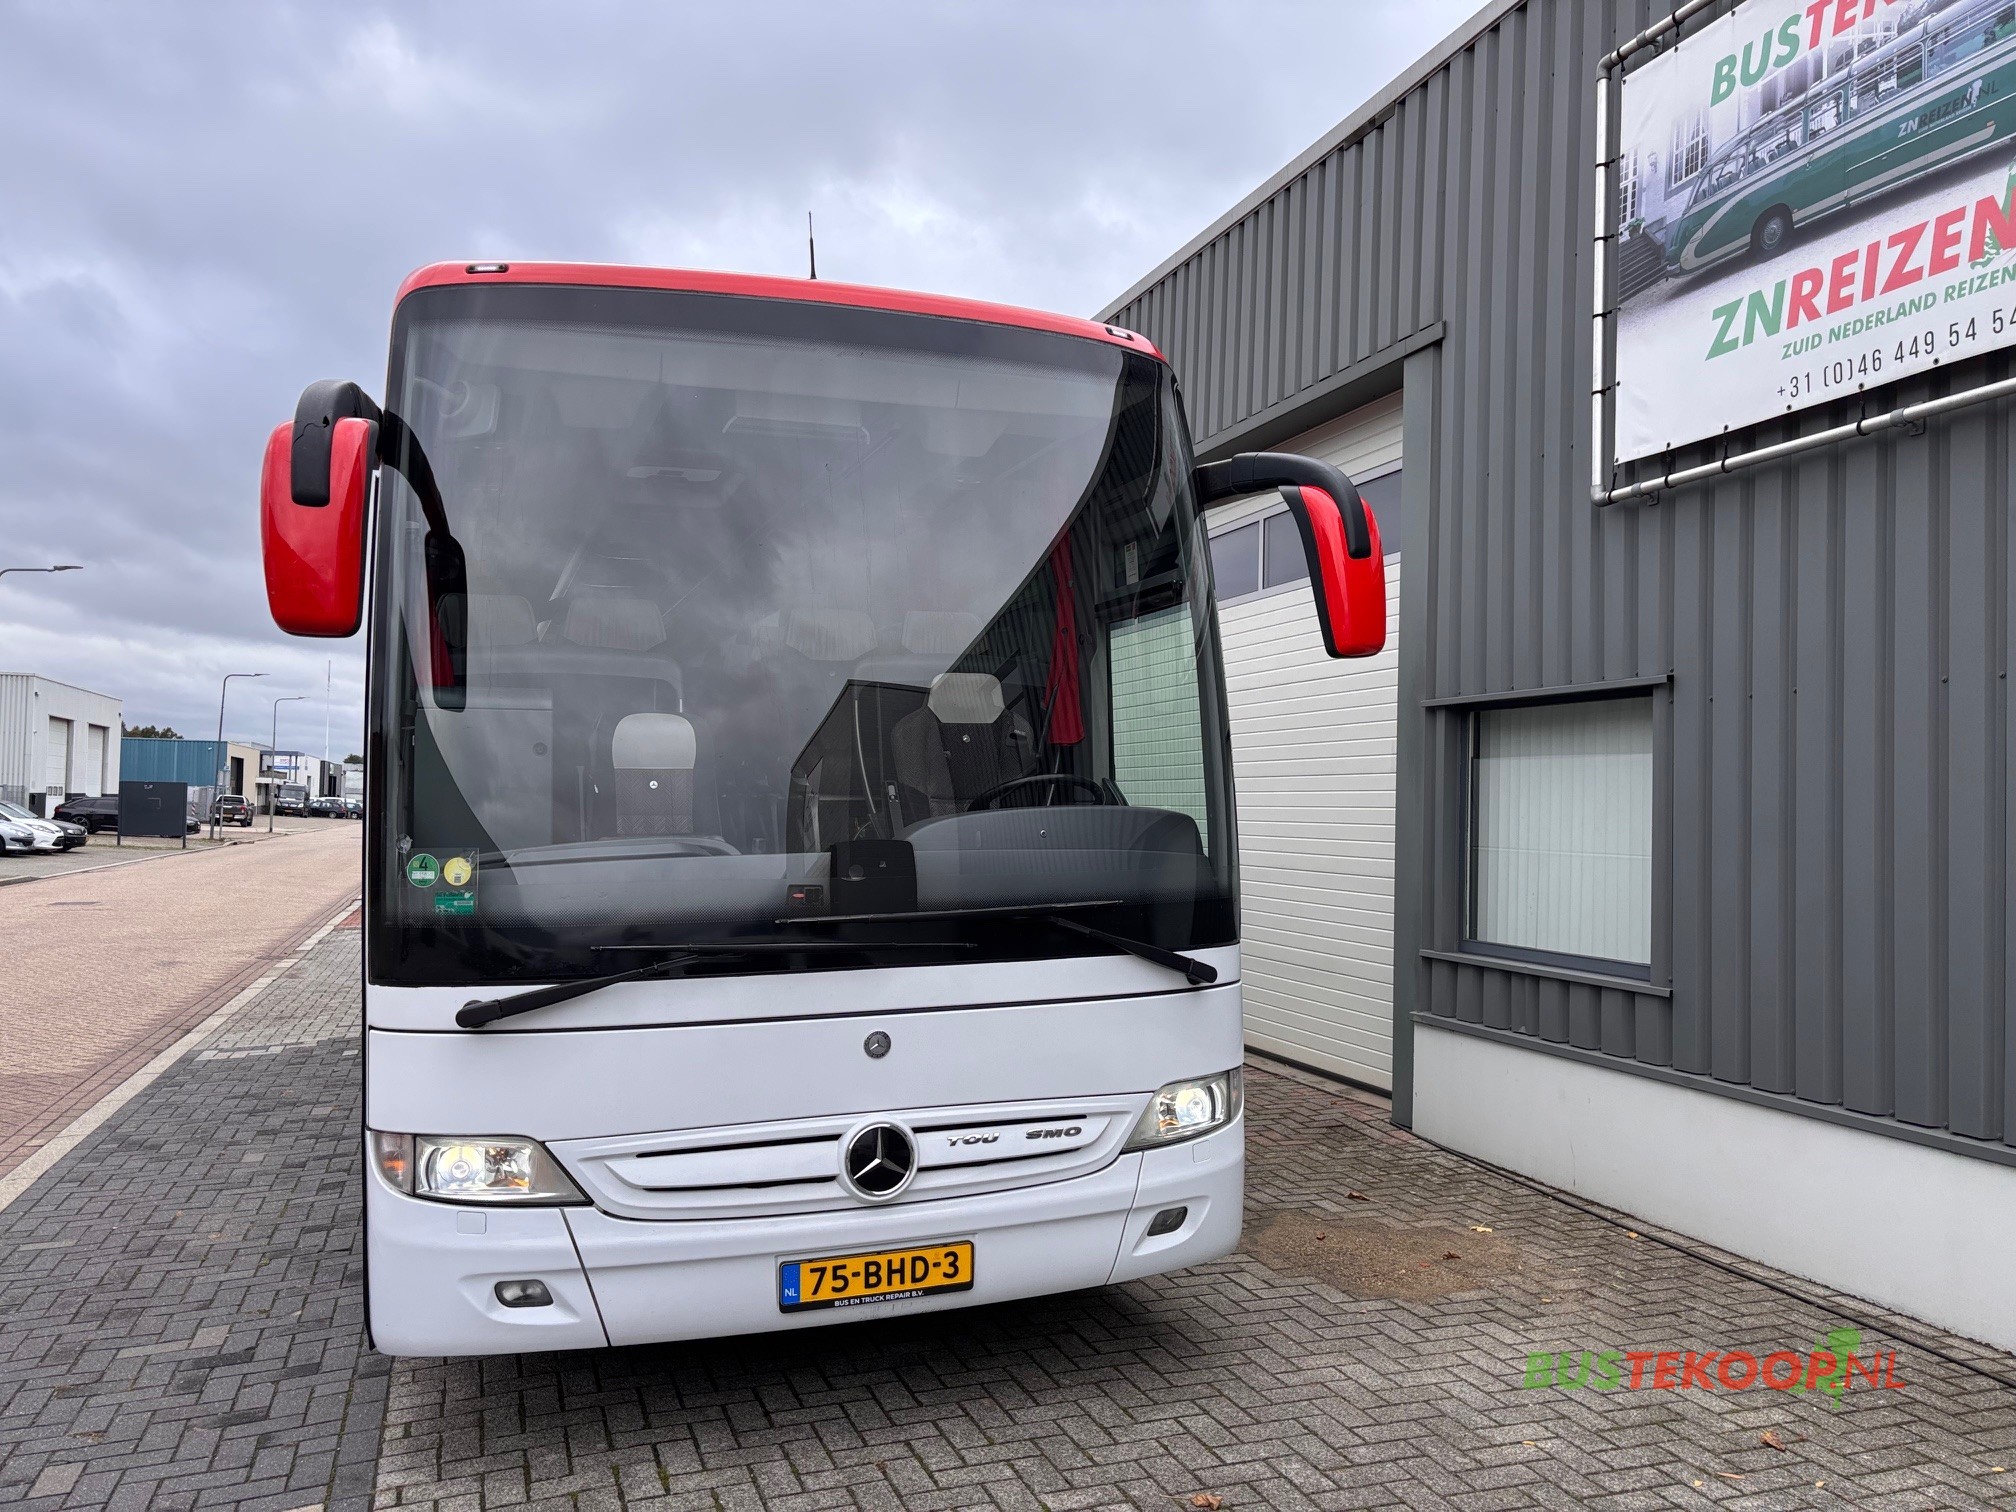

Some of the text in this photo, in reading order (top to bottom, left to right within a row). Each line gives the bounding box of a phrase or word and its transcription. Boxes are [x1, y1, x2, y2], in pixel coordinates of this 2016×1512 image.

[1781, 263, 2016, 360] ZUID NEDERLAND REIZEN
[1777, 371, 1811, 398] +31
[1823, 349, 1882, 387] (0)46
[1894, 330, 1935, 364] 449
[1949, 317, 1977, 347] 54
[419, 856, 428, 871] 4
[947, 1126, 1082, 1147] TOU SMO
[784, 1250, 960, 1297] NL 75-BHD-3
[834, 1289, 924, 1307] BUS EN TRUCK REPAIR B.V.
